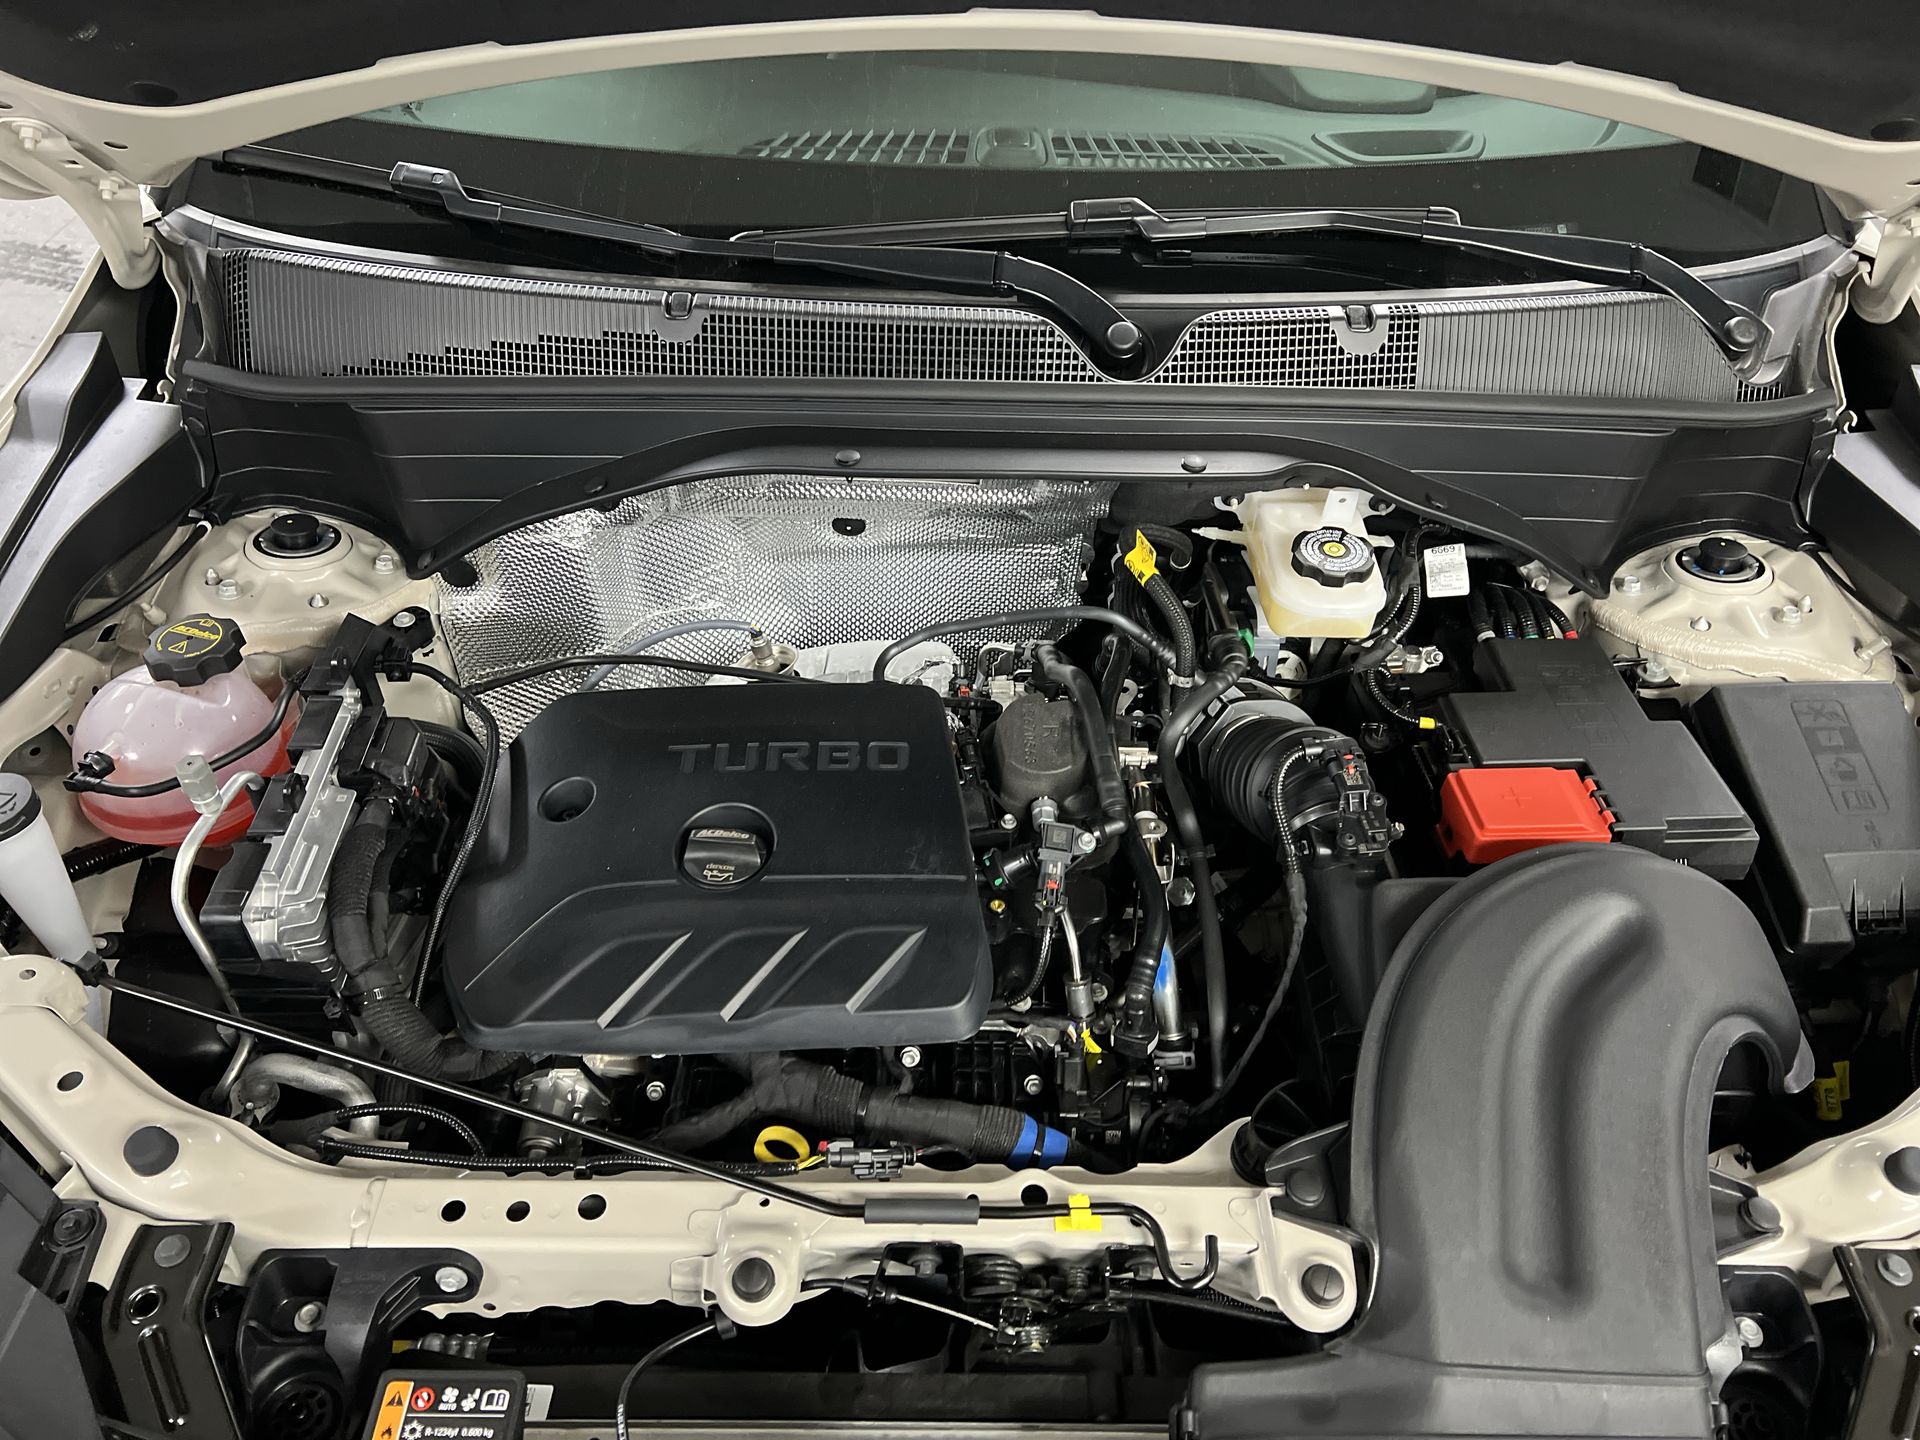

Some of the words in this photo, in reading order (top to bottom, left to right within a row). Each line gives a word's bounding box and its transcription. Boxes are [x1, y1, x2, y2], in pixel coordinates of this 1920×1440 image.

[668, 741, 910, 773] TURBO
[696, 829, 750, 839] ACDelco
[438, 1402, 457, 1411] AUTO
[424, 1427, 460, 1439] R-1234yf
[483, 1427, 495, 1439] kg
